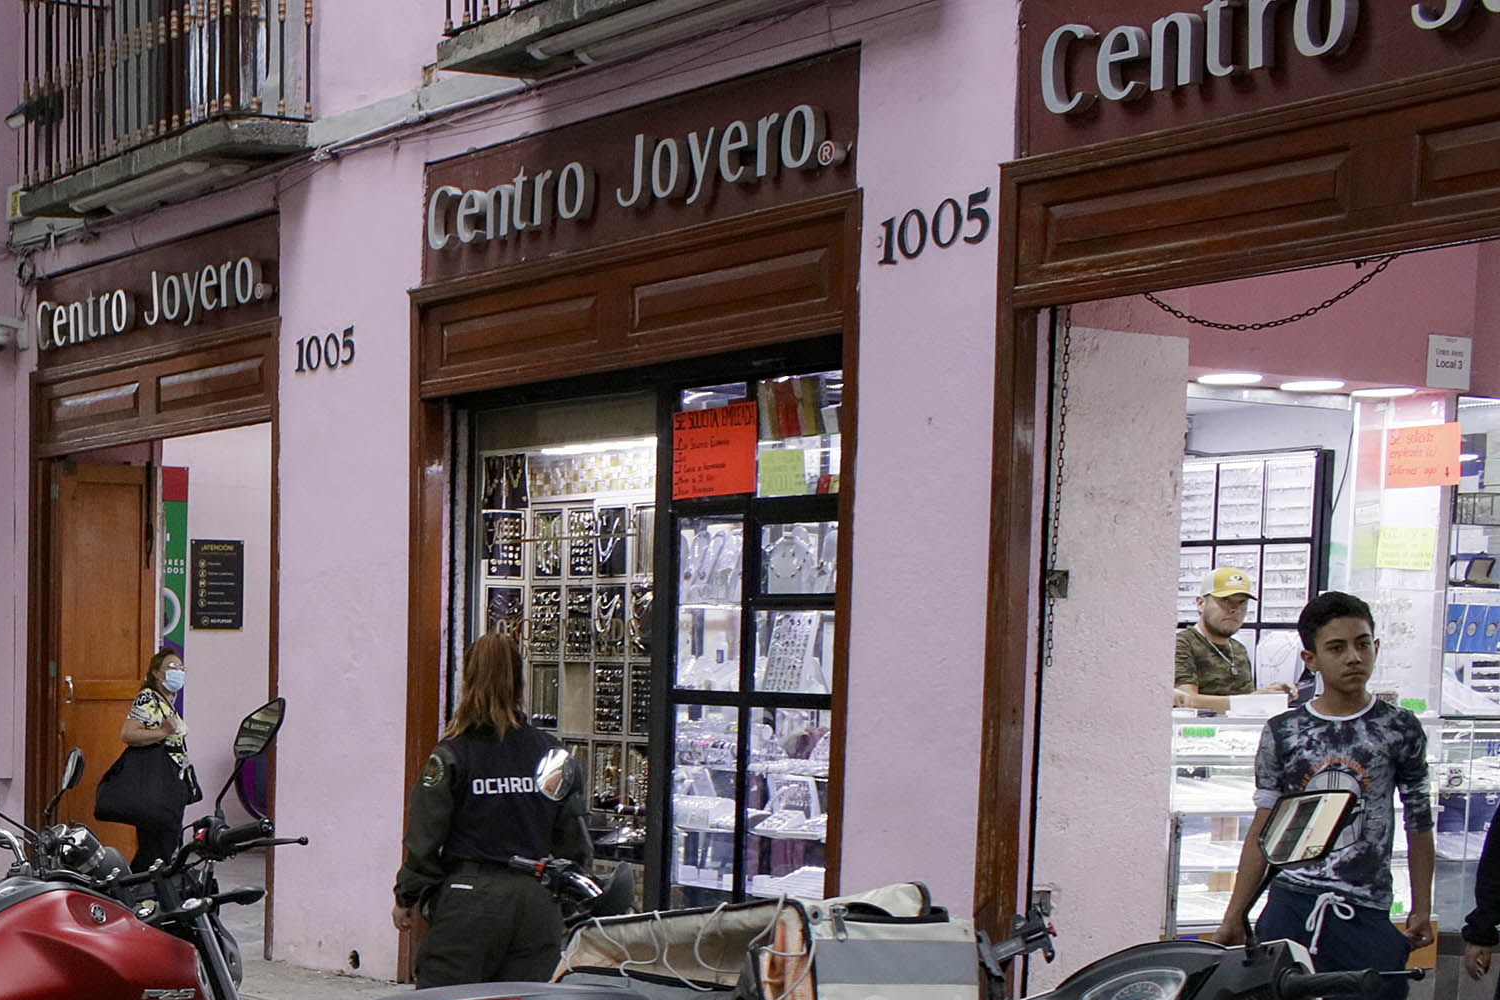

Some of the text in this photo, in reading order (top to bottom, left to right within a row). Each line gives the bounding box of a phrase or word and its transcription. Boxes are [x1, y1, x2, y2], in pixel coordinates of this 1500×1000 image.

[427, 160, 586, 251] Centro
[878, 187, 991, 266] 1005
[37, 289, 128, 350] Centro
[295, 325, 356, 374] 1005
[1435, 358, 1463, 370] Local 3
